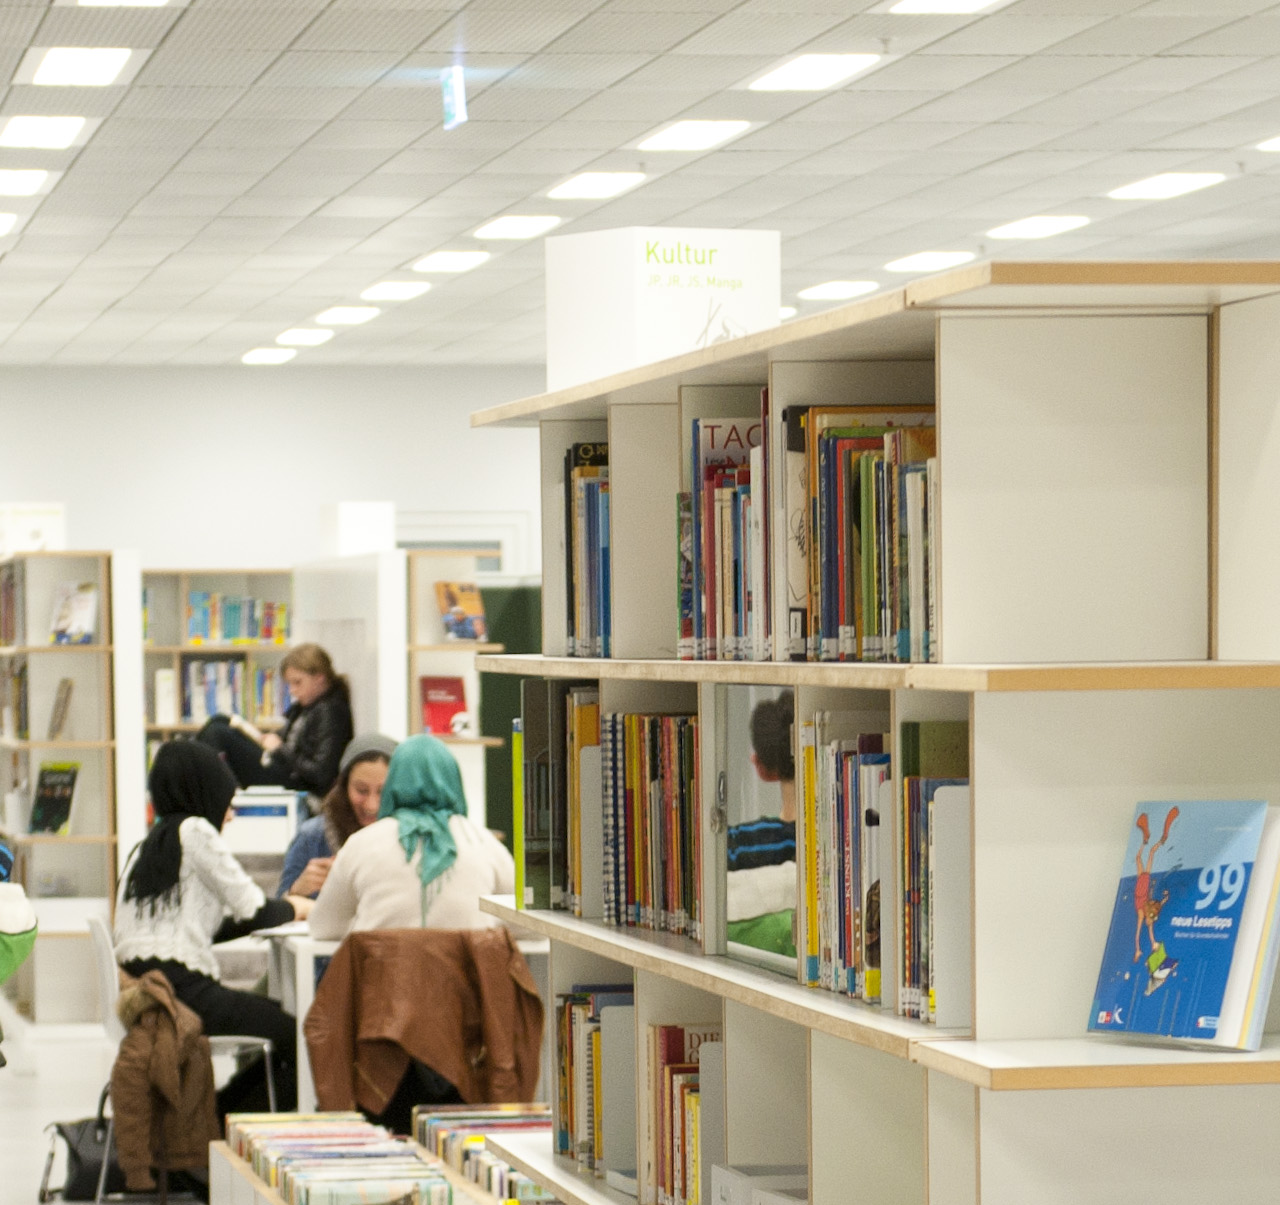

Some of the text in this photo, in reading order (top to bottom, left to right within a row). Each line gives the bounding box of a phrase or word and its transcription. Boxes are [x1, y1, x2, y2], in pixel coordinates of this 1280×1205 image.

[646, 241, 718, 265] Kultur
[706, 276, 743, 291] Manga
[1195, 862, 1246, 911] 99
[1192, 914, 1232, 930] Lesetipps
